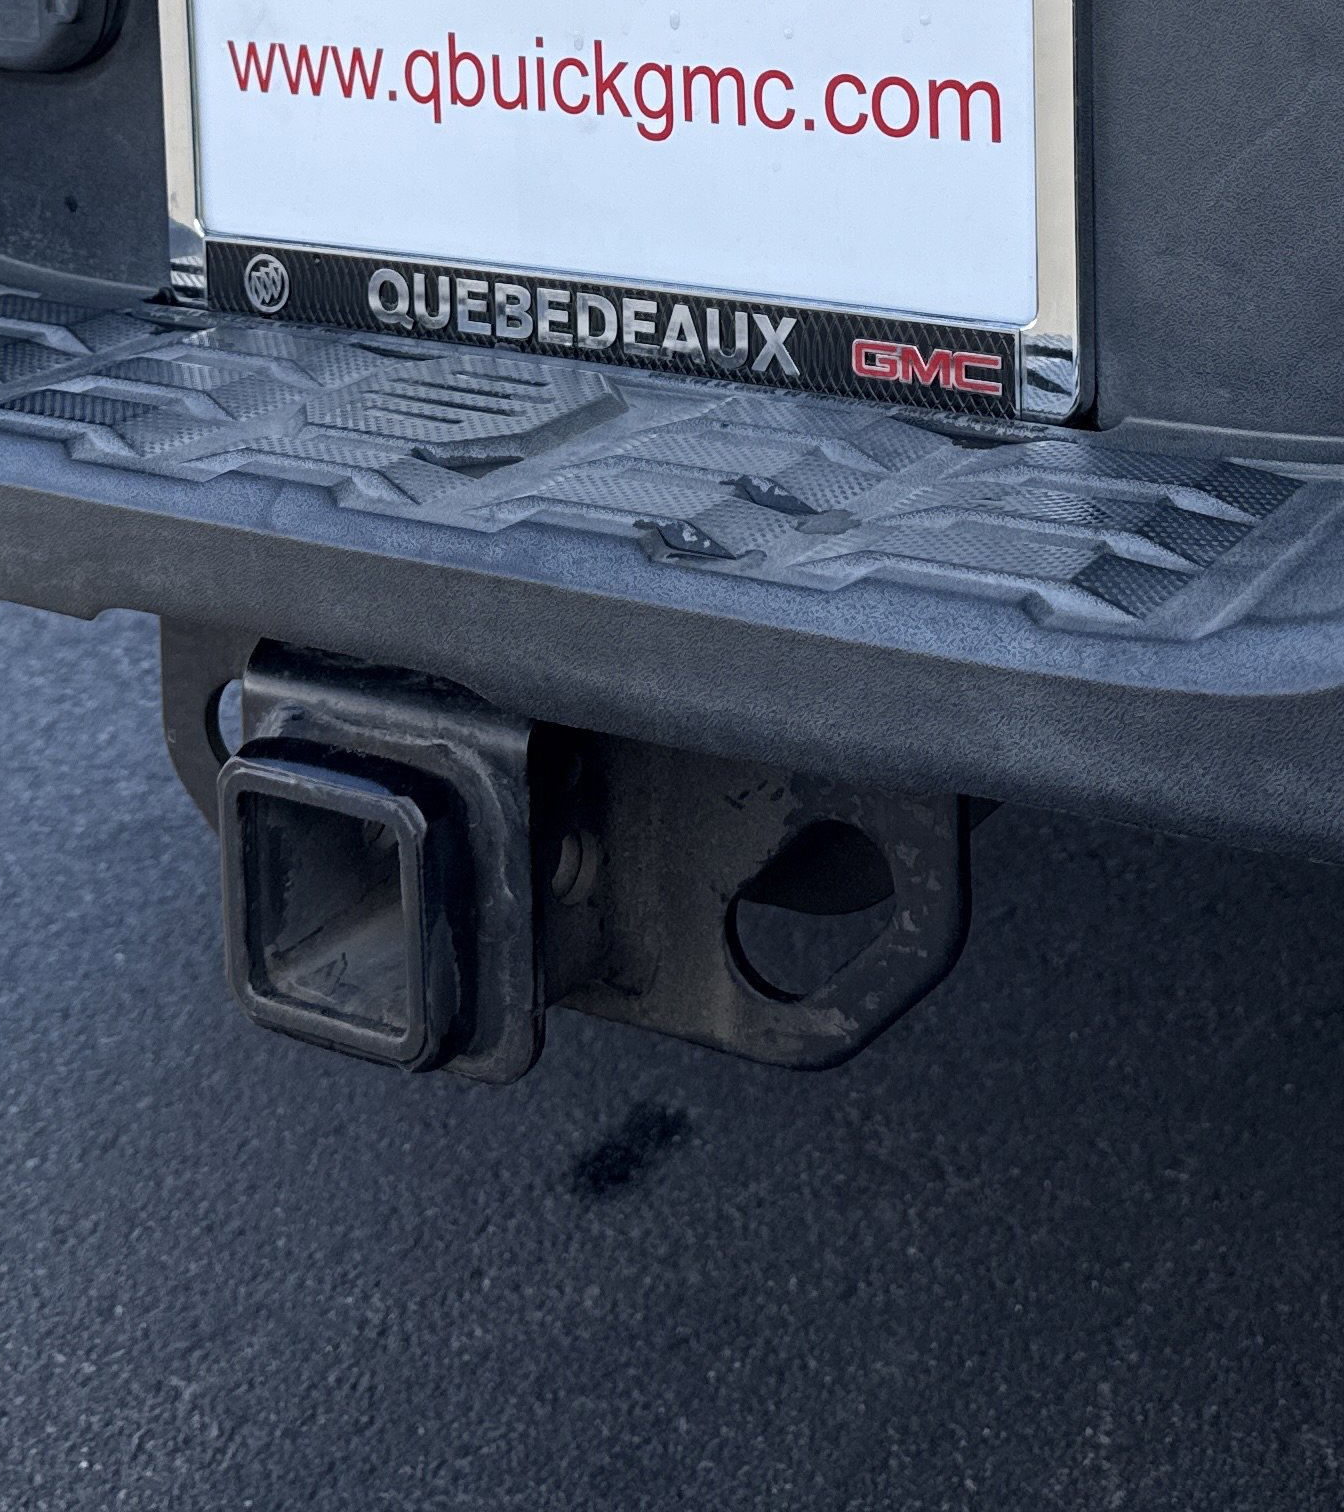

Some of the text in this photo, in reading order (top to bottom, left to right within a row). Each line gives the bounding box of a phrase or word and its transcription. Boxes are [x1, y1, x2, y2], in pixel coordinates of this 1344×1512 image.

[228, 33, 1002, 143] www.qbuickgmc.com
[367, 268, 801, 376] QUEBEDEAUX
[851, 338, 1003, 396] GMC
